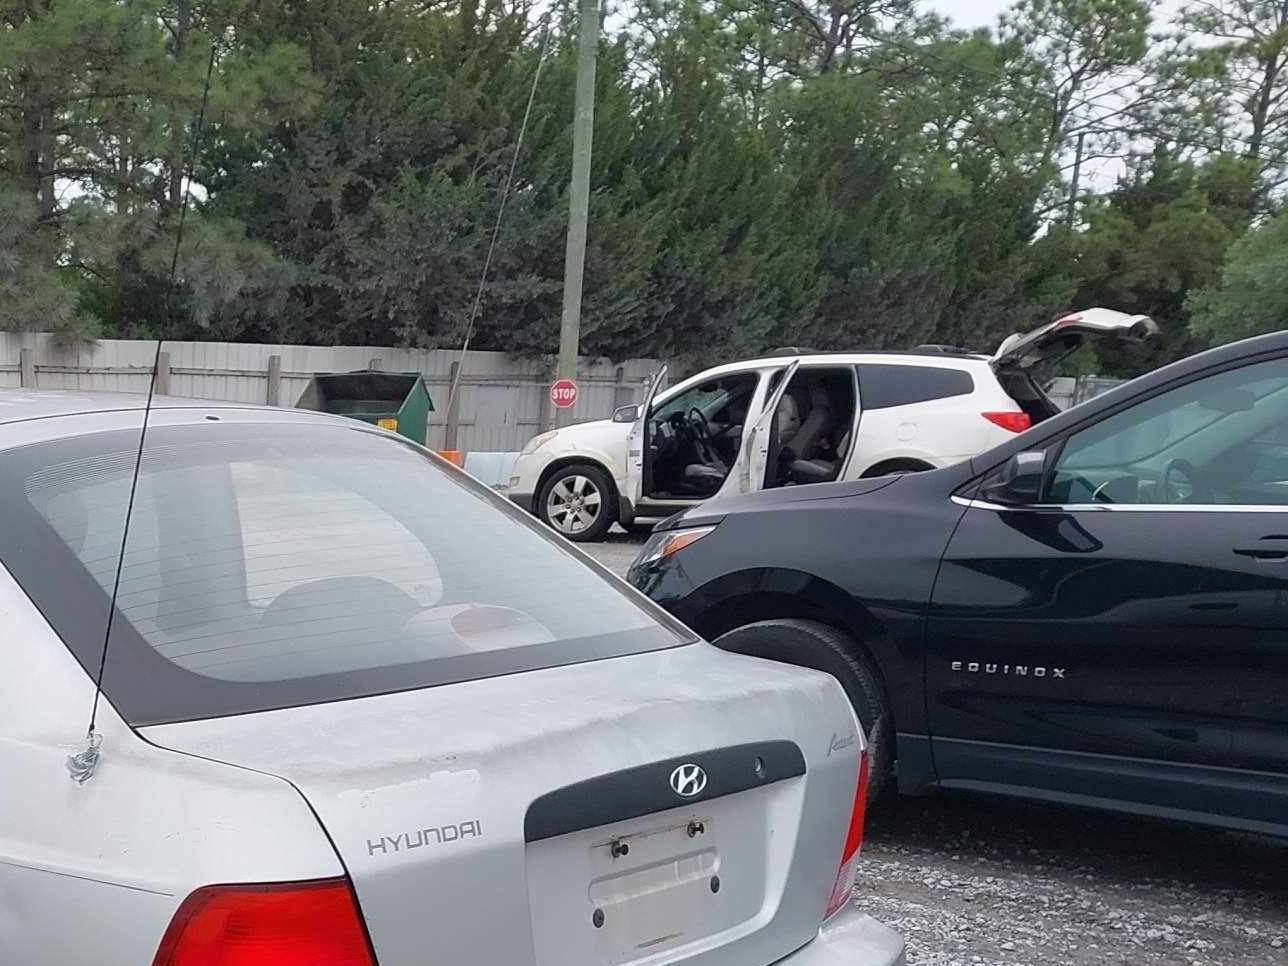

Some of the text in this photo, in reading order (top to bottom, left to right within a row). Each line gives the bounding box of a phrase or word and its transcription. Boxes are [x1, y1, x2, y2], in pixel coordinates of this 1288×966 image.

[552, 388, 576, 400] STOP
[951, 661, 1065, 679] EQUINOX
[366, 819, 483, 856] HYUNDAI
